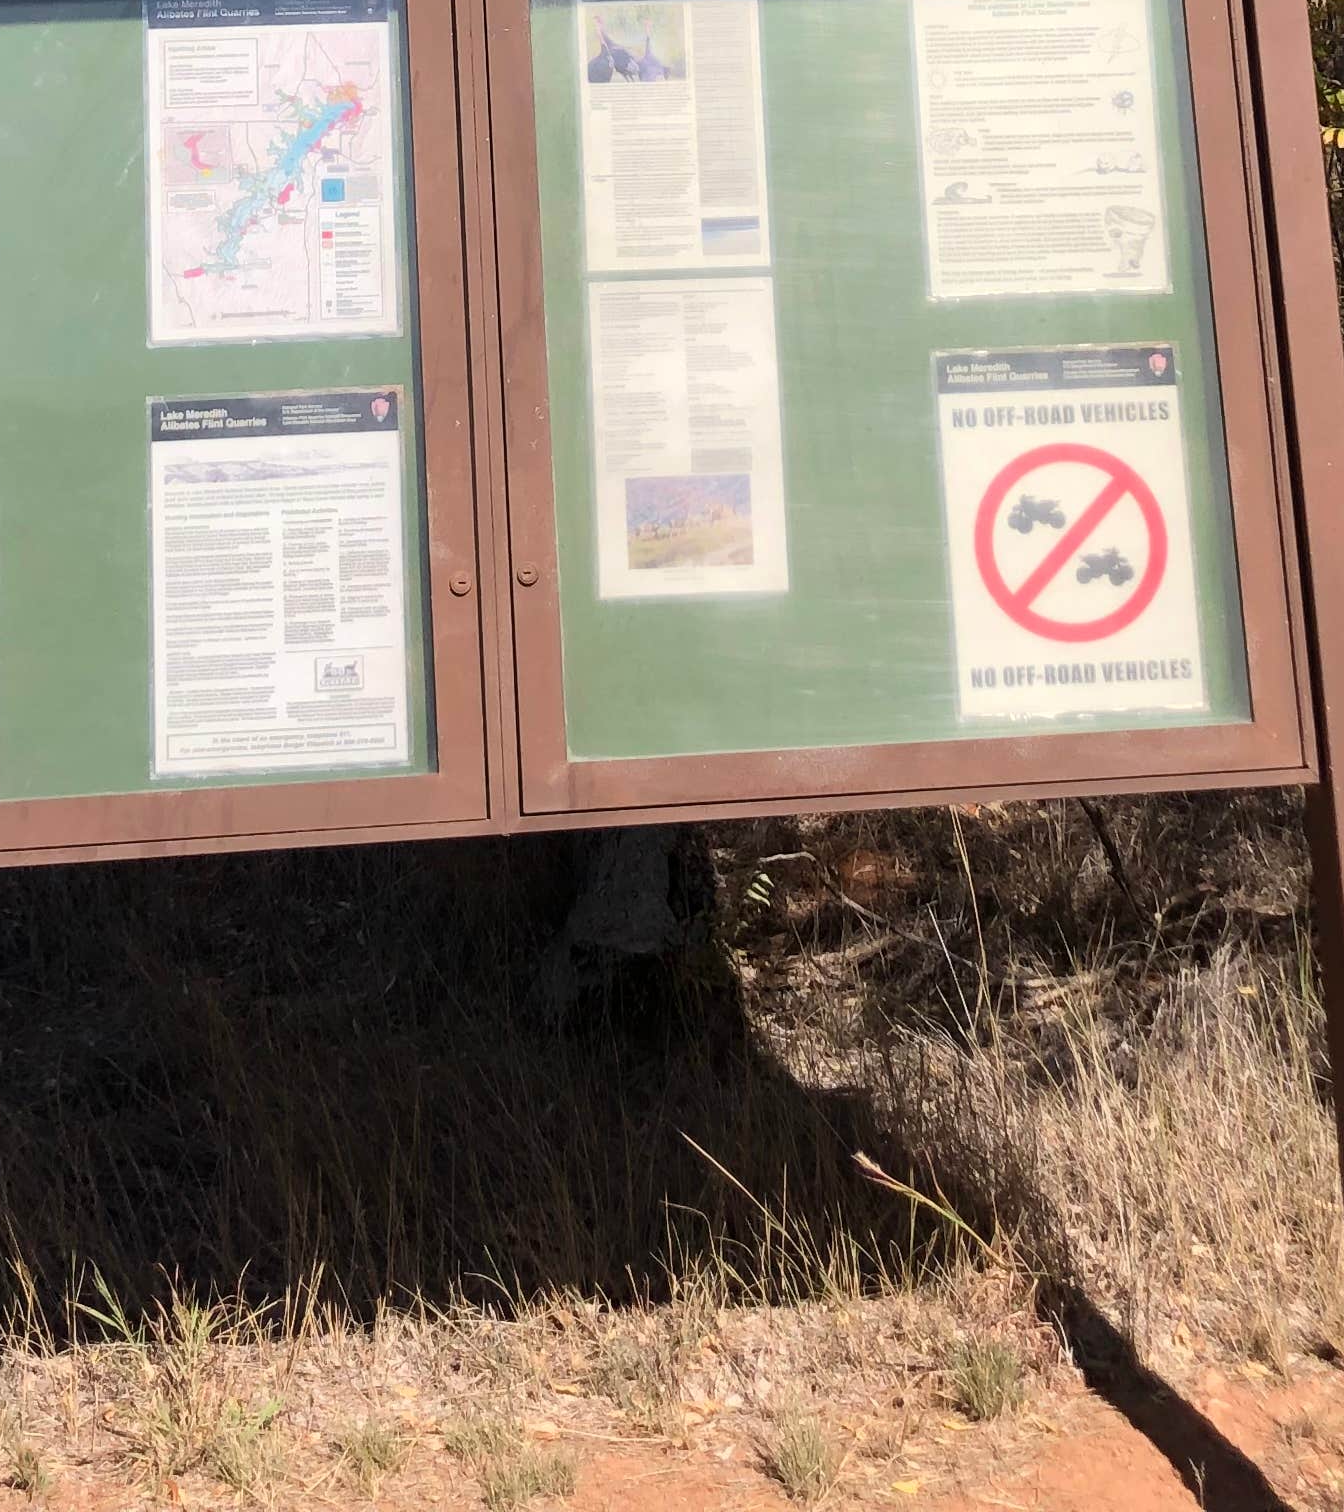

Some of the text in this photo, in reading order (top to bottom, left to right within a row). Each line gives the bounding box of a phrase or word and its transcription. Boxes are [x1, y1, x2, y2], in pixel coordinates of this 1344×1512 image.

[160, 408, 228, 420] Lake Meredith
[952, 400, 1169, 427] NO OFF-ROAD VEHICLES
[202, 418, 224, 429] Flint
[971, 658, 1192, 688] NO OFF-ROAD VEHICLES
